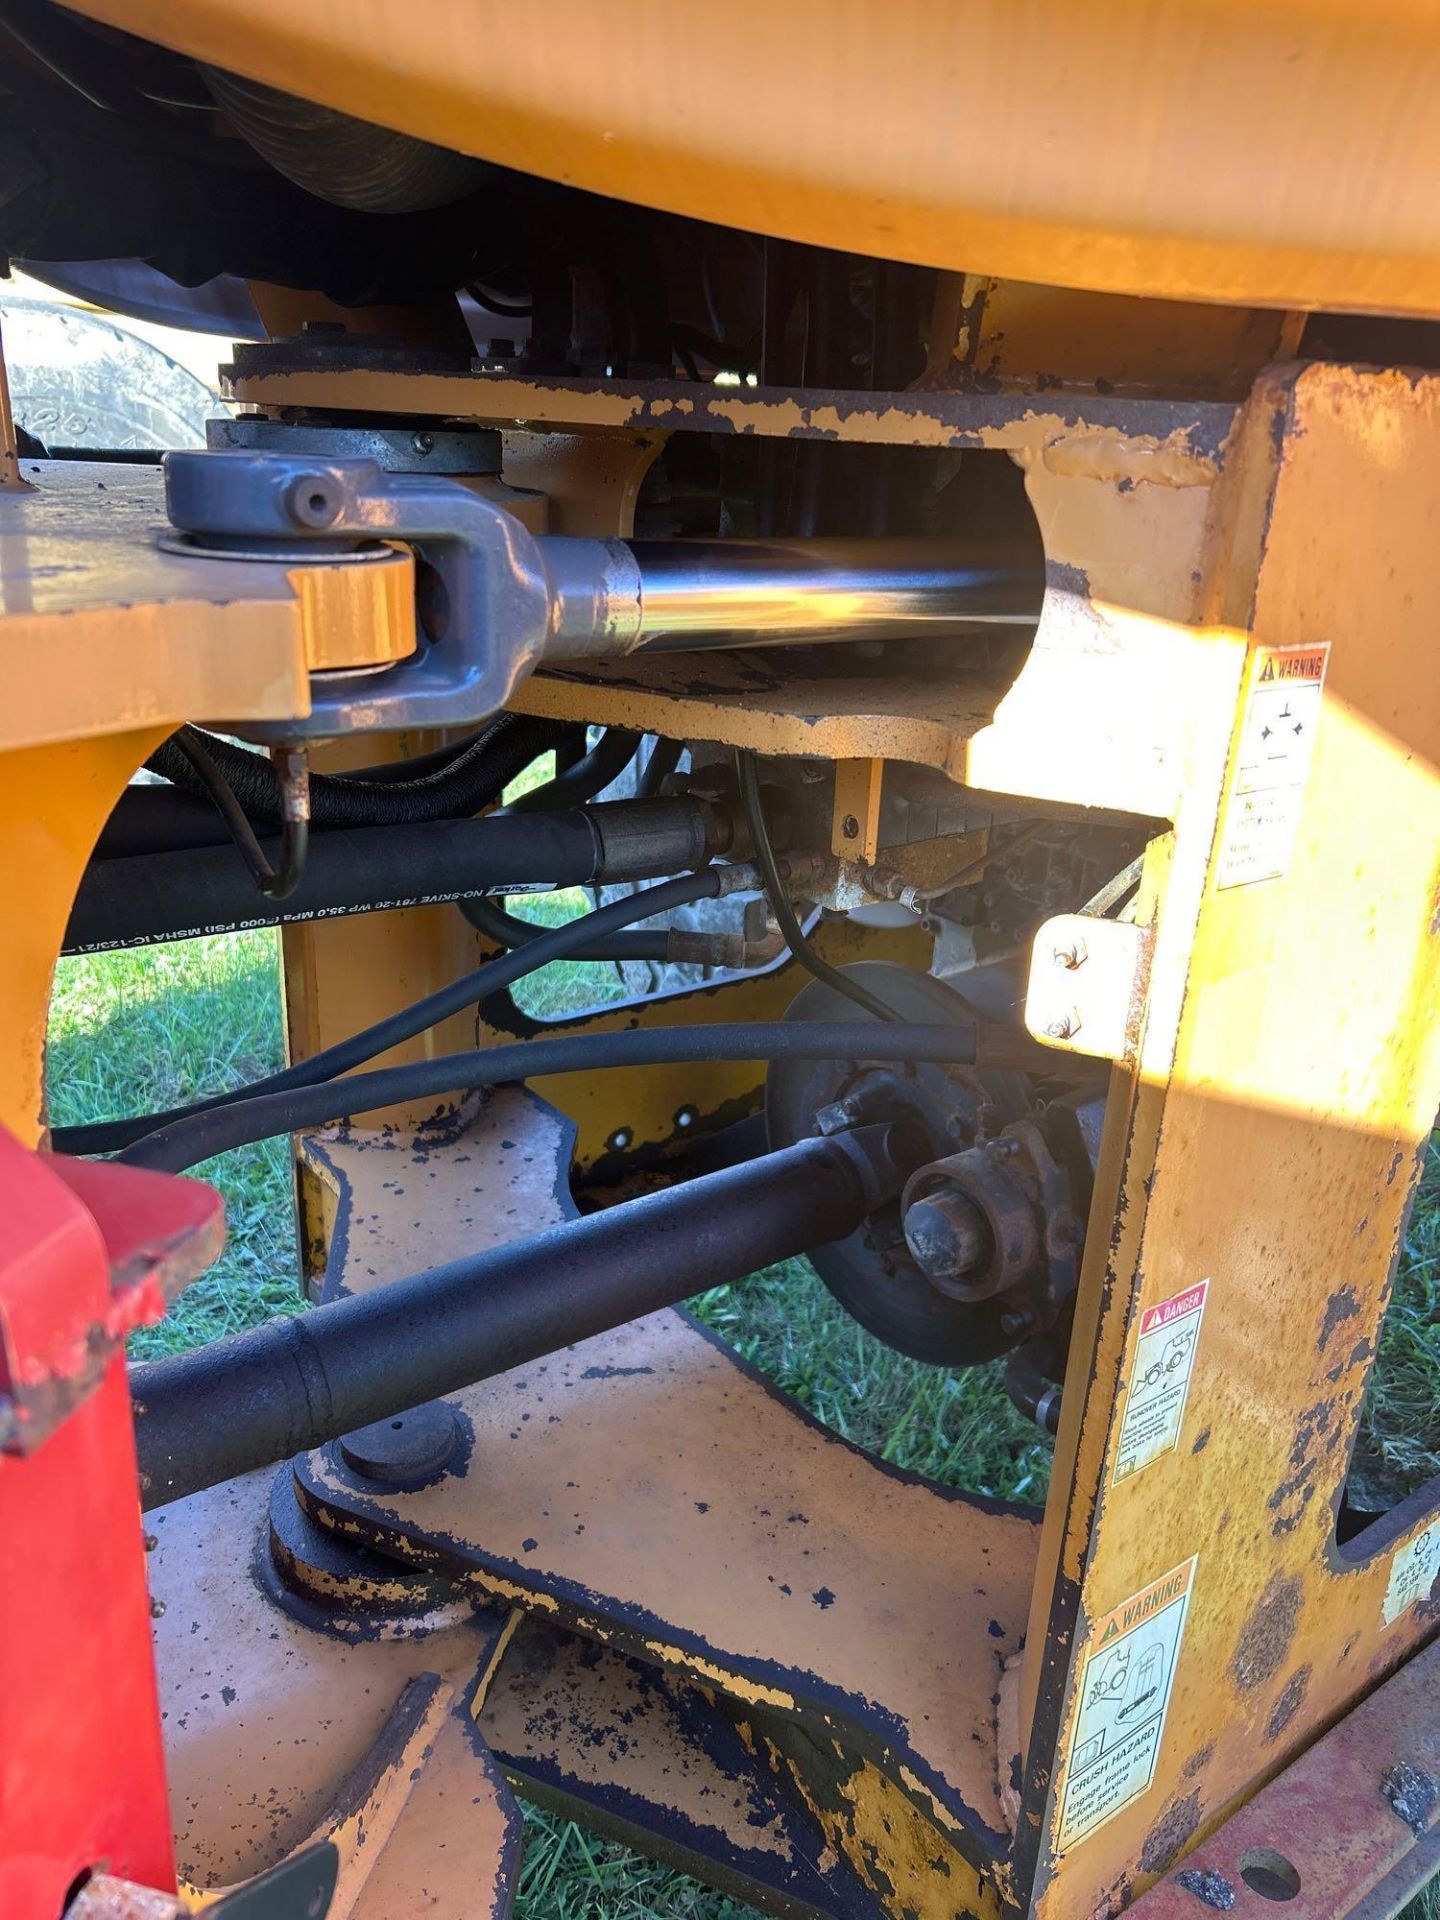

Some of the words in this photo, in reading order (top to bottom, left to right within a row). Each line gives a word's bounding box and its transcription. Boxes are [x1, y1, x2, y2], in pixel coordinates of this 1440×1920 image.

[1278, 656, 1322, 678] WARNING
[375, 897, 417, 909] 781-20
[421, 889, 483, 903] NO-SKIVE
[283, 910, 314, 922] MPa
[347, 903, 371, 912] WP
[154, 927, 200, 941] MSHA
[205, 922, 236, 934] PSI)
[1163, 1291, 1200, 1320] DANGER
[1159, 1389, 1181, 1405] HAZARD
[1122, 1573, 1184, 1629] WARNING
[1071, 1762, 1109, 1796] CRUSH
[1111, 1726, 1155, 1765] HAZARD
[1067, 1782, 1102, 1814] Engage
[1104, 1760, 1131, 1786] frame
[1133, 1746, 1152, 1764] lock
[1065, 1798, 1095, 1825] before
[1097, 1773, 1129, 1802] service
[1063, 1825, 1075, 1838] or
[1076, 1793, 1121, 1828] transport.
